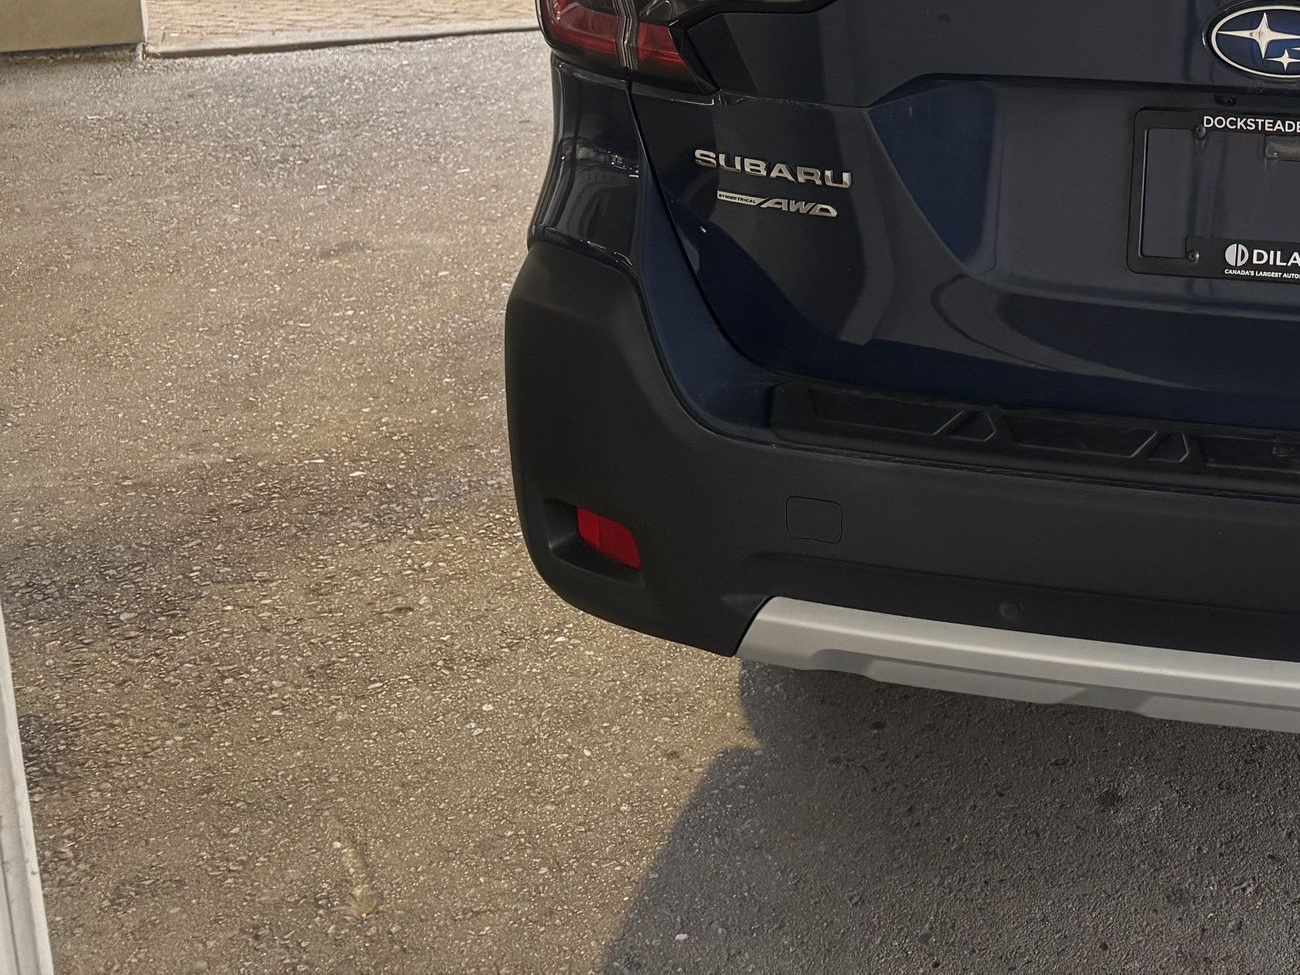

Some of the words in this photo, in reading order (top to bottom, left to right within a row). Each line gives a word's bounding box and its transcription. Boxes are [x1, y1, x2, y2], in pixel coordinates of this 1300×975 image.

[694, 149, 852, 190] SUBARU
[760, 197, 838, 218] AWD
[1224, 268, 1255, 276] CANADA'S
[1255, 270, 1283, 278] LARGEST
